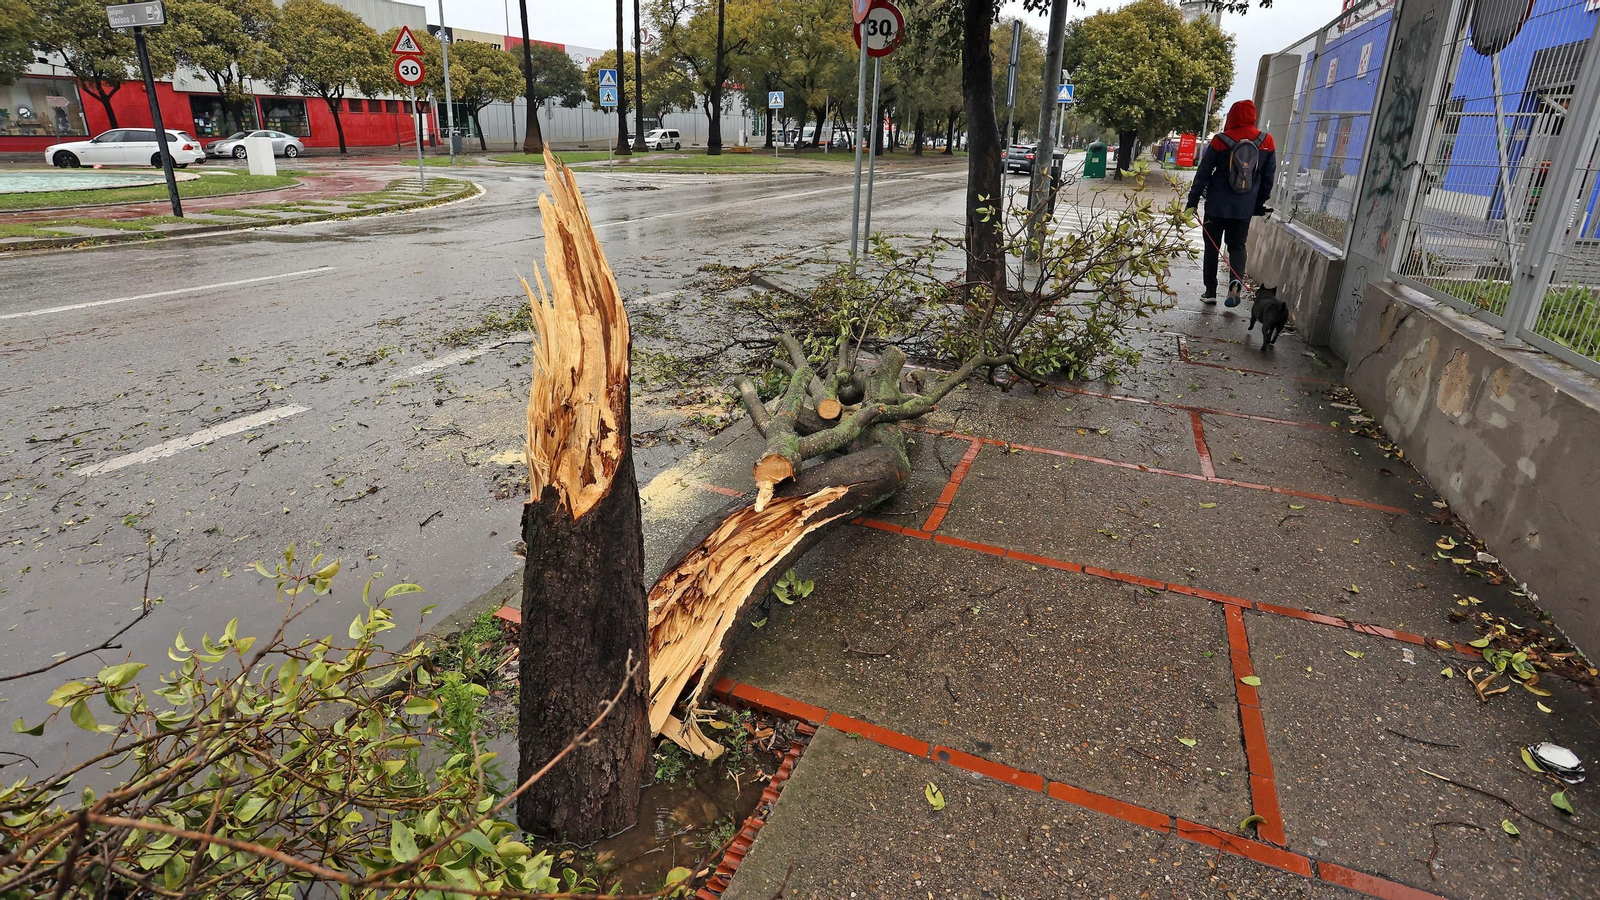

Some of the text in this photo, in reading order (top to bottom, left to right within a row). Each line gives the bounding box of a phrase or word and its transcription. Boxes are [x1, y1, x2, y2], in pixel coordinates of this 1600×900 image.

[131, 14, 136, 23] 2
[867, 19, 892, 37] 30
[401, 65, 419, 76] 30
